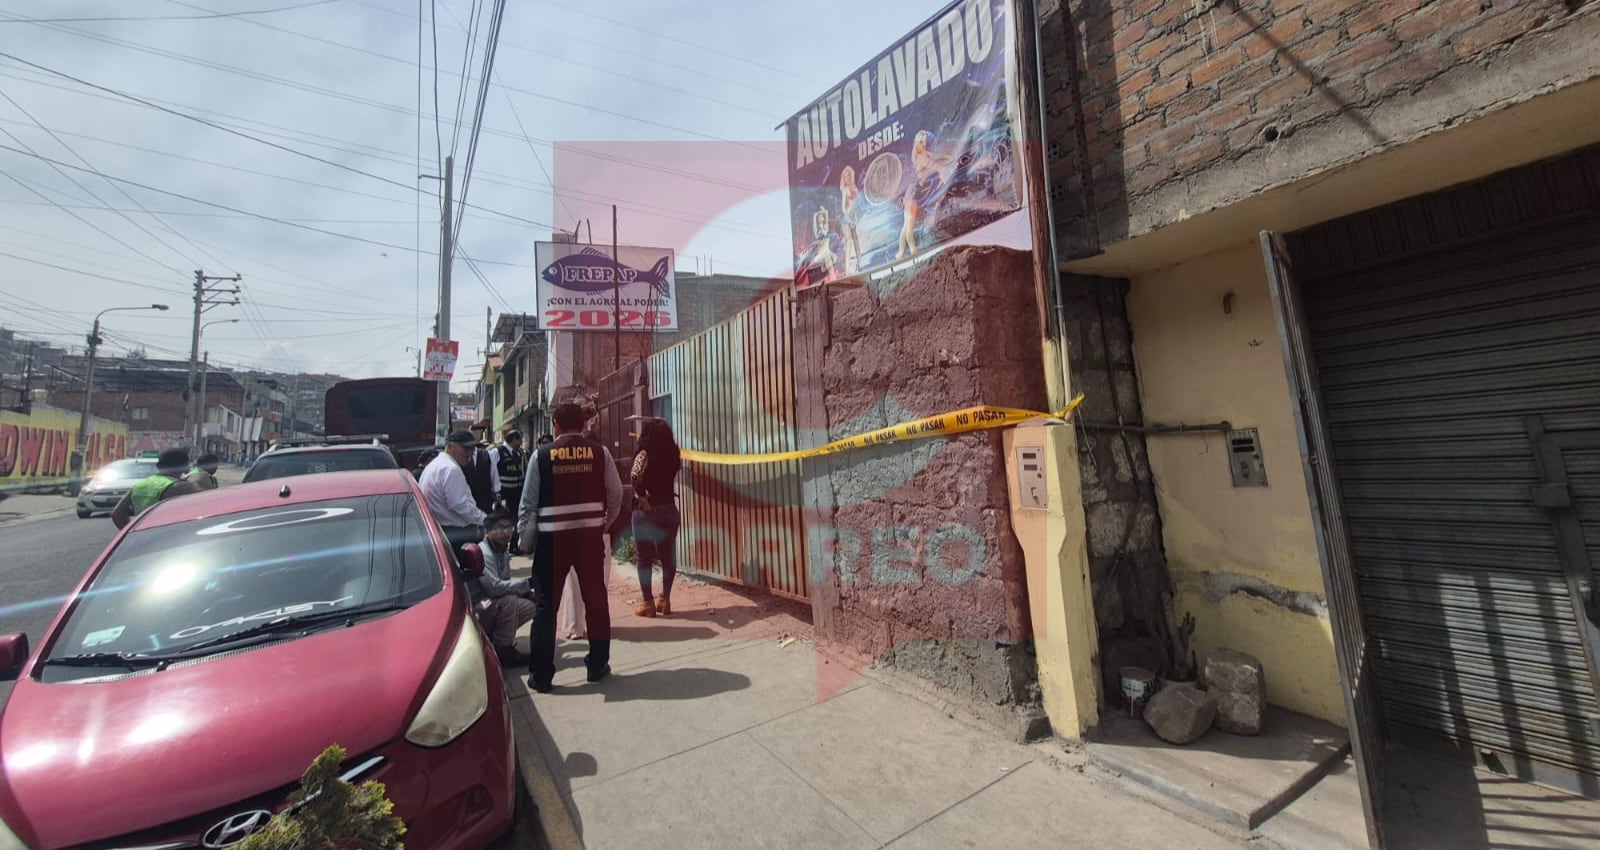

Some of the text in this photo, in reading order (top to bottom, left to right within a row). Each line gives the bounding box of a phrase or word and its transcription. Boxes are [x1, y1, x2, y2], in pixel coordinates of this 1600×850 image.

[797, 0, 993, 169] AUTOLAVADO
[858, 120, 905, 161] DESDE:
[565, 266, 637, 282] FREPAP
[574, 298, 588, 306] EL
[590, 298, 616, 306] AGRO
[619, 298, 633, 306] AL
[545, 309, 672, 327] 2026
[906, 425, 918, 436] NO
[920, 418, 945, 434] PASAR
[957, 415, 969, 426] NO
[549, 446, 594, 462] POLICIA
